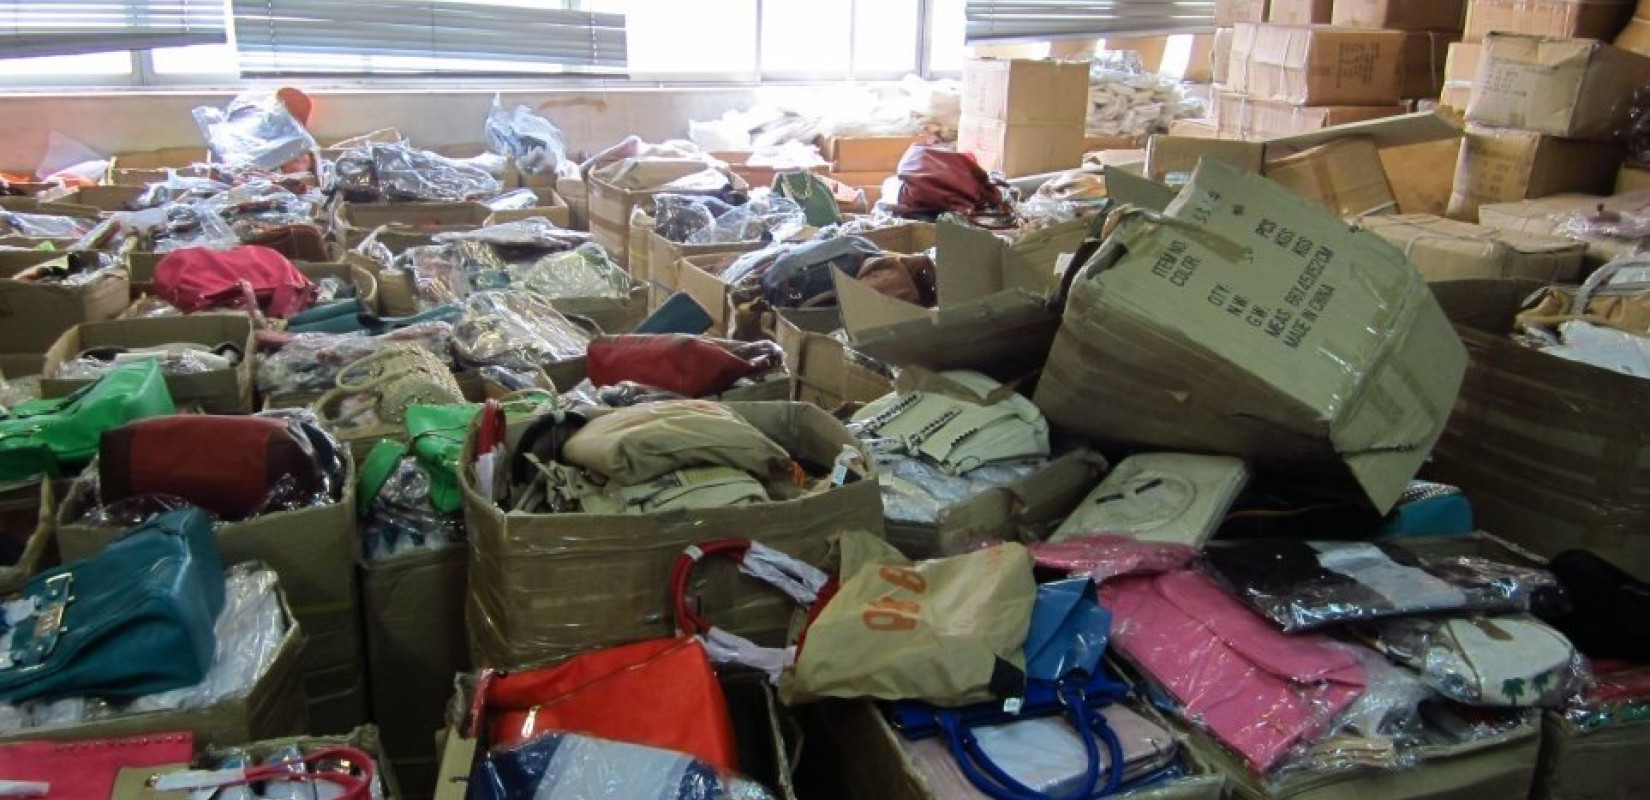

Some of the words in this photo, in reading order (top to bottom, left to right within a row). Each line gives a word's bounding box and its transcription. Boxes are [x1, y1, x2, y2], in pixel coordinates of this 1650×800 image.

[1308, 284, 1336, 312] CHINA
[1301, 308, 1319, 322] IN
[1282, 319, 1312, 349] MADE
